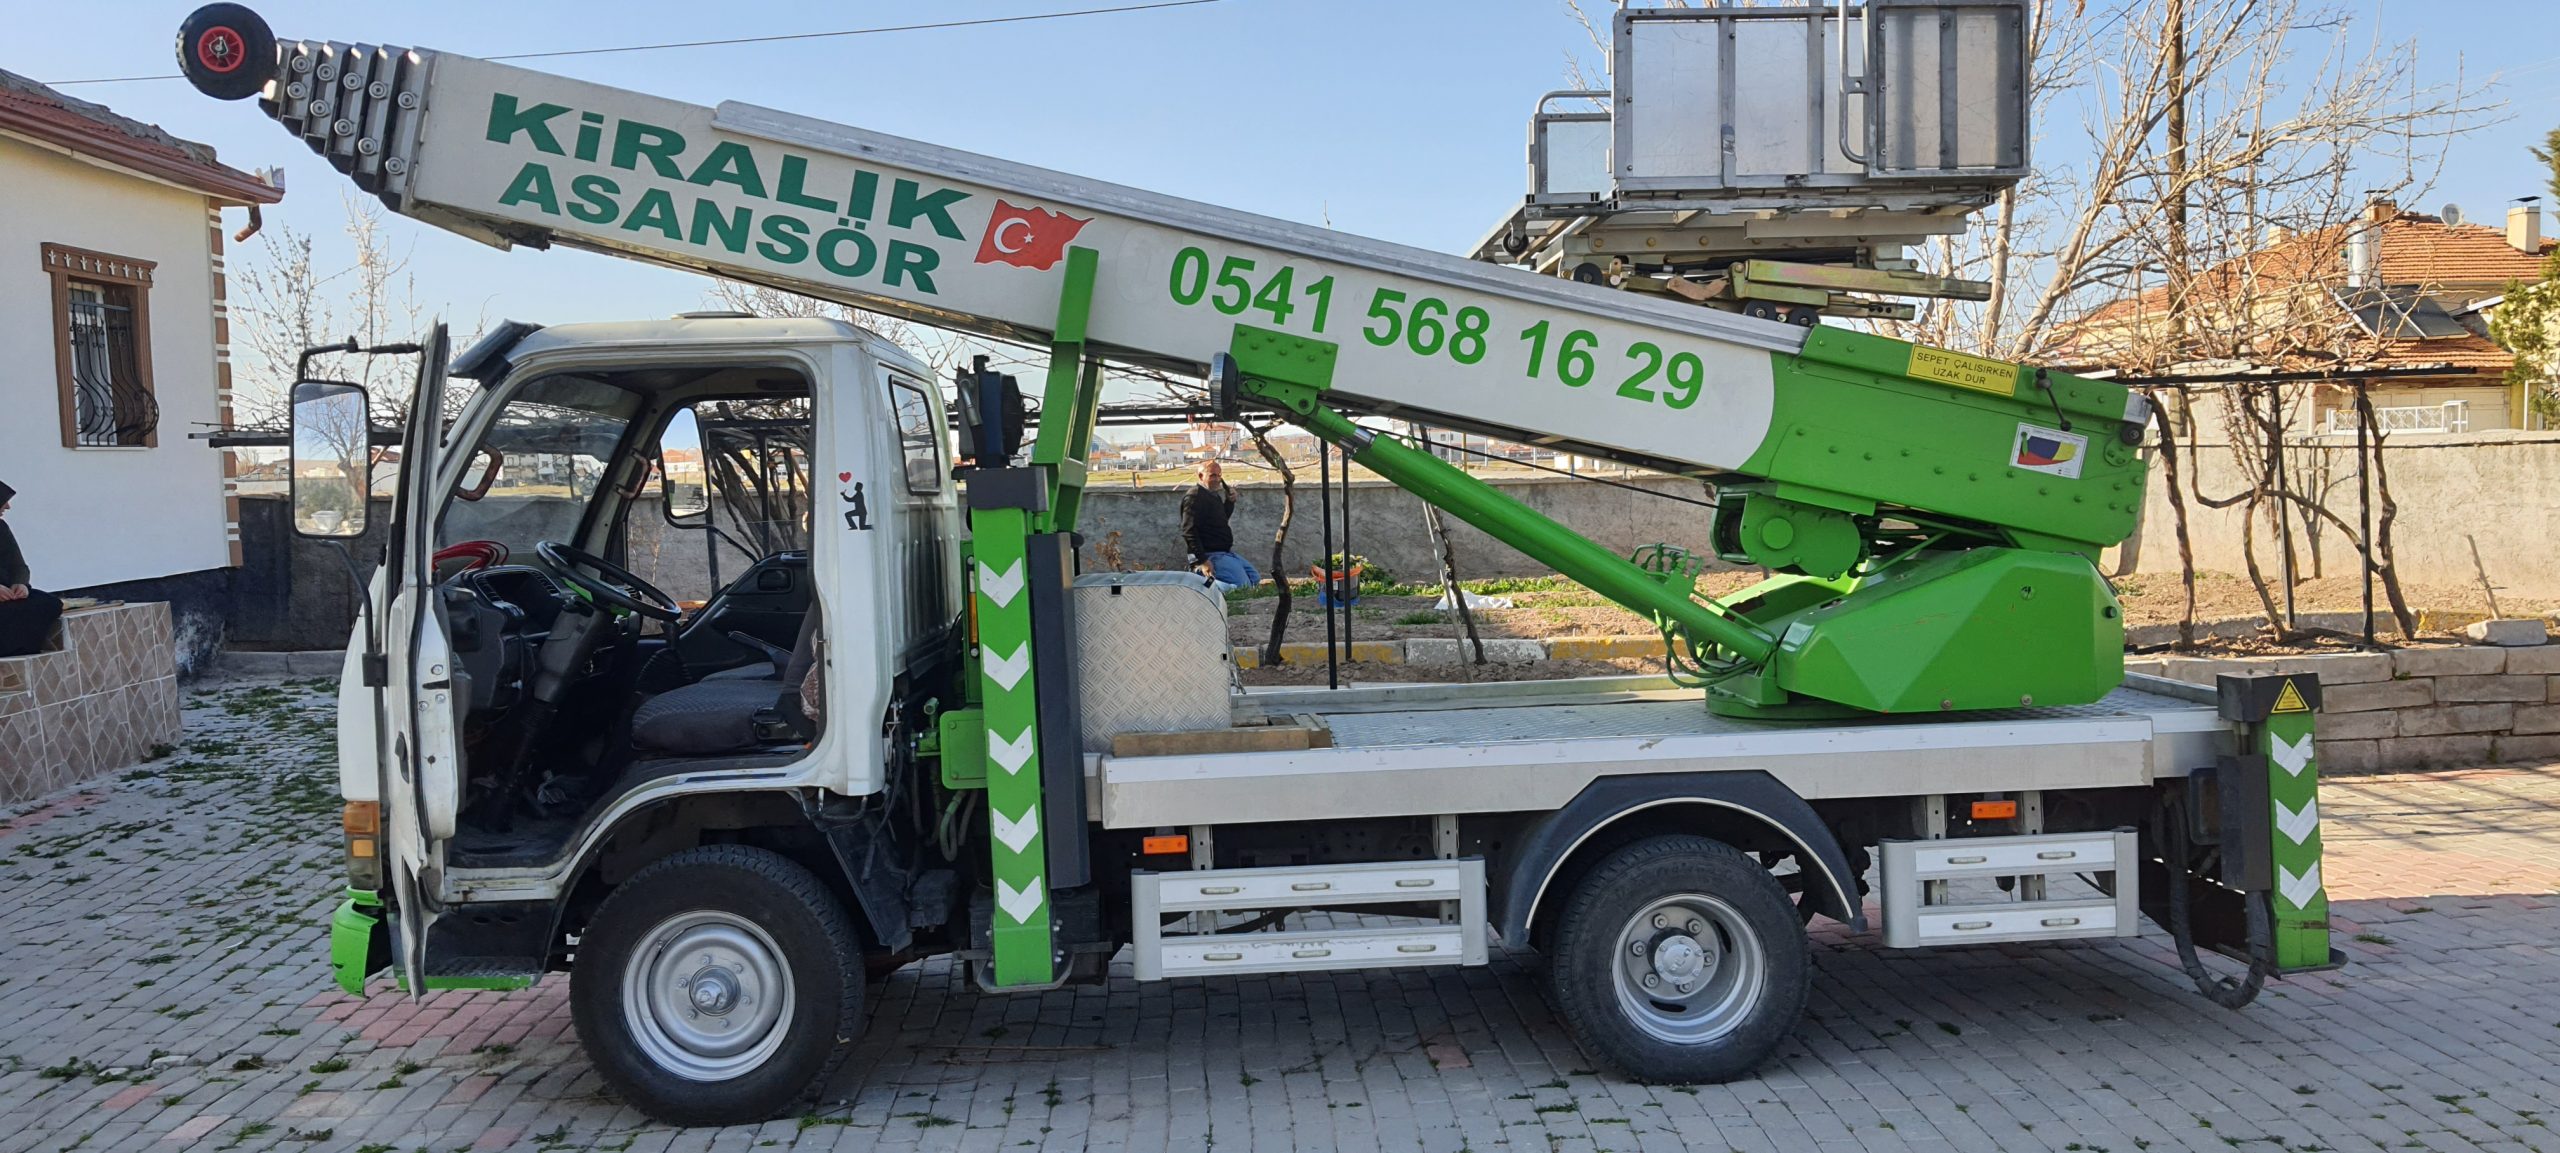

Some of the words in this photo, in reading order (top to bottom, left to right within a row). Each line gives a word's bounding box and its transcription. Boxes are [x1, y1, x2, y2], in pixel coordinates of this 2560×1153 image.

[498, 163, 940, 295] ASANSÖR
[1169, 247, 1334, 333] 0541
[1363, 287, 1490, 365] 568
[1520, 320, 1598, 388] 16
[1616, 341, 1704, 410] 29
[1917, 352, 1949, 366] SEPET
[1933, 367, 1960, 380] UZAK
[1964, 374, 1986, 385] DUR
